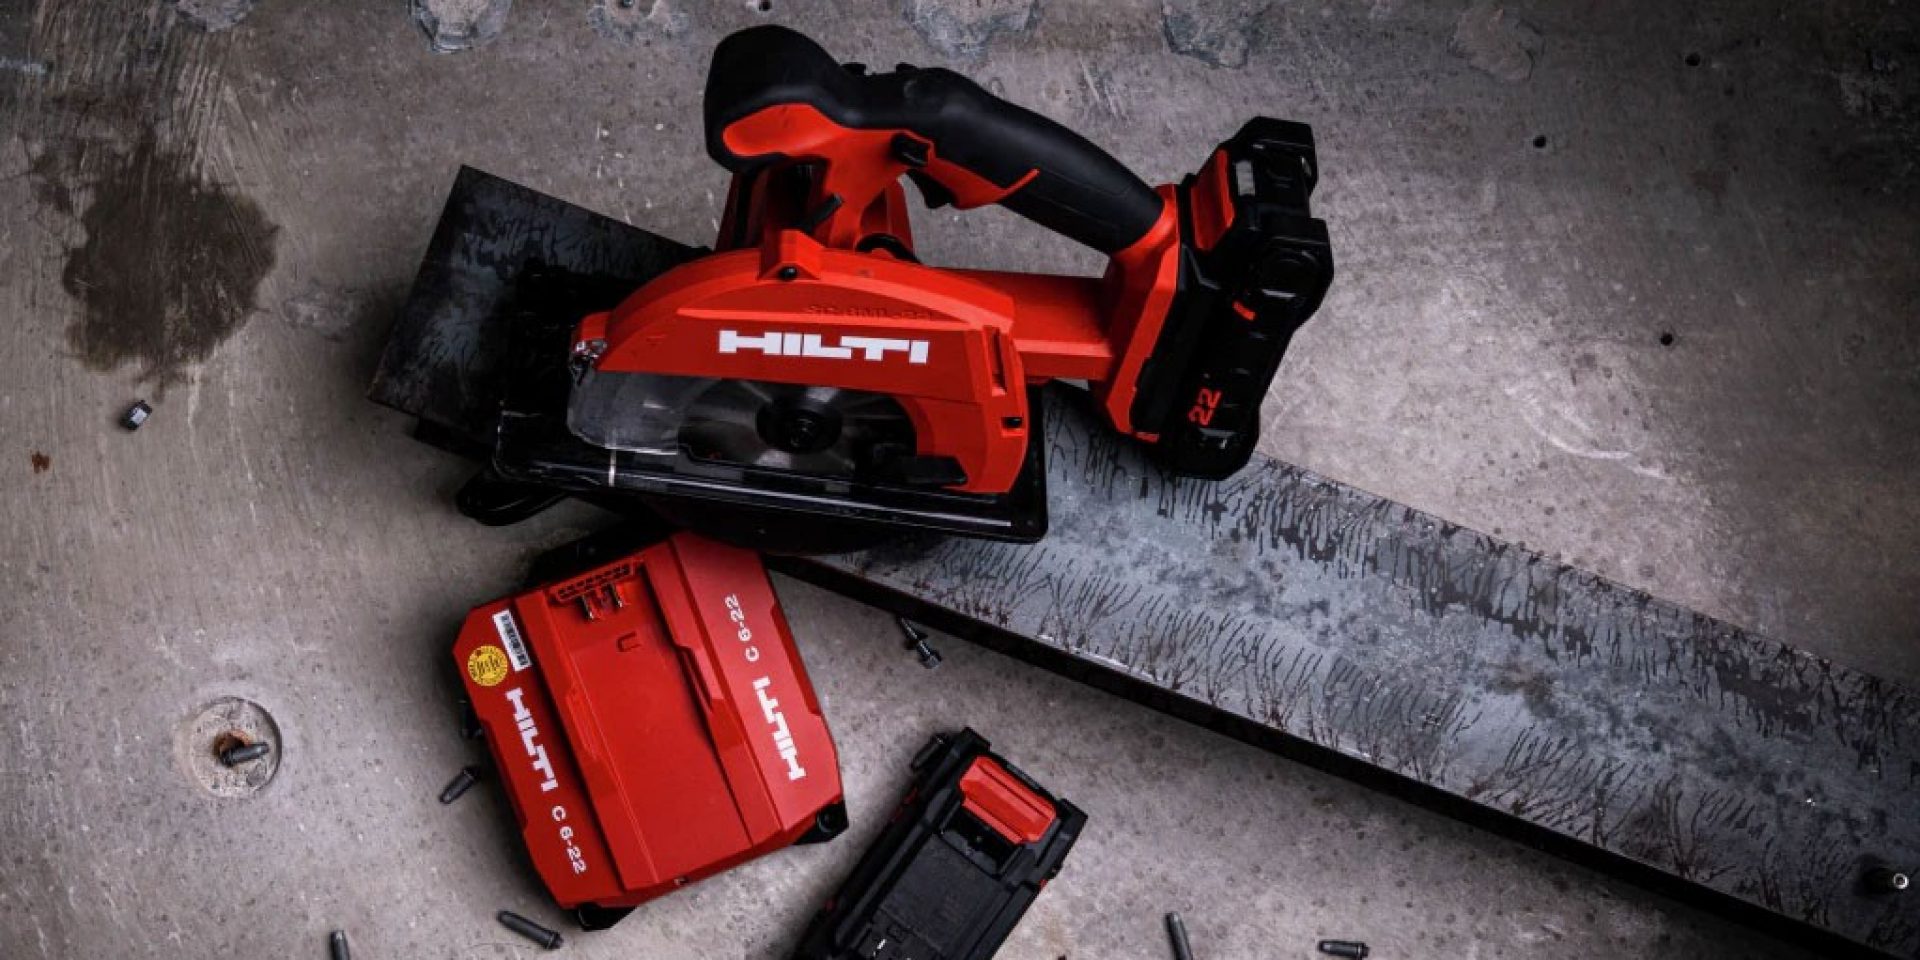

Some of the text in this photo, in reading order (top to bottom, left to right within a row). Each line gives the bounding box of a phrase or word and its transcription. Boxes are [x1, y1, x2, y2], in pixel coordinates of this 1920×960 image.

[719, 331, 929, 364] HILTI
[1188, 388, 1222, 426] 22
[724, 594, 807, 781] HILTI C 6-22
[506, 687, 588, 875] HILTI C 6-22
